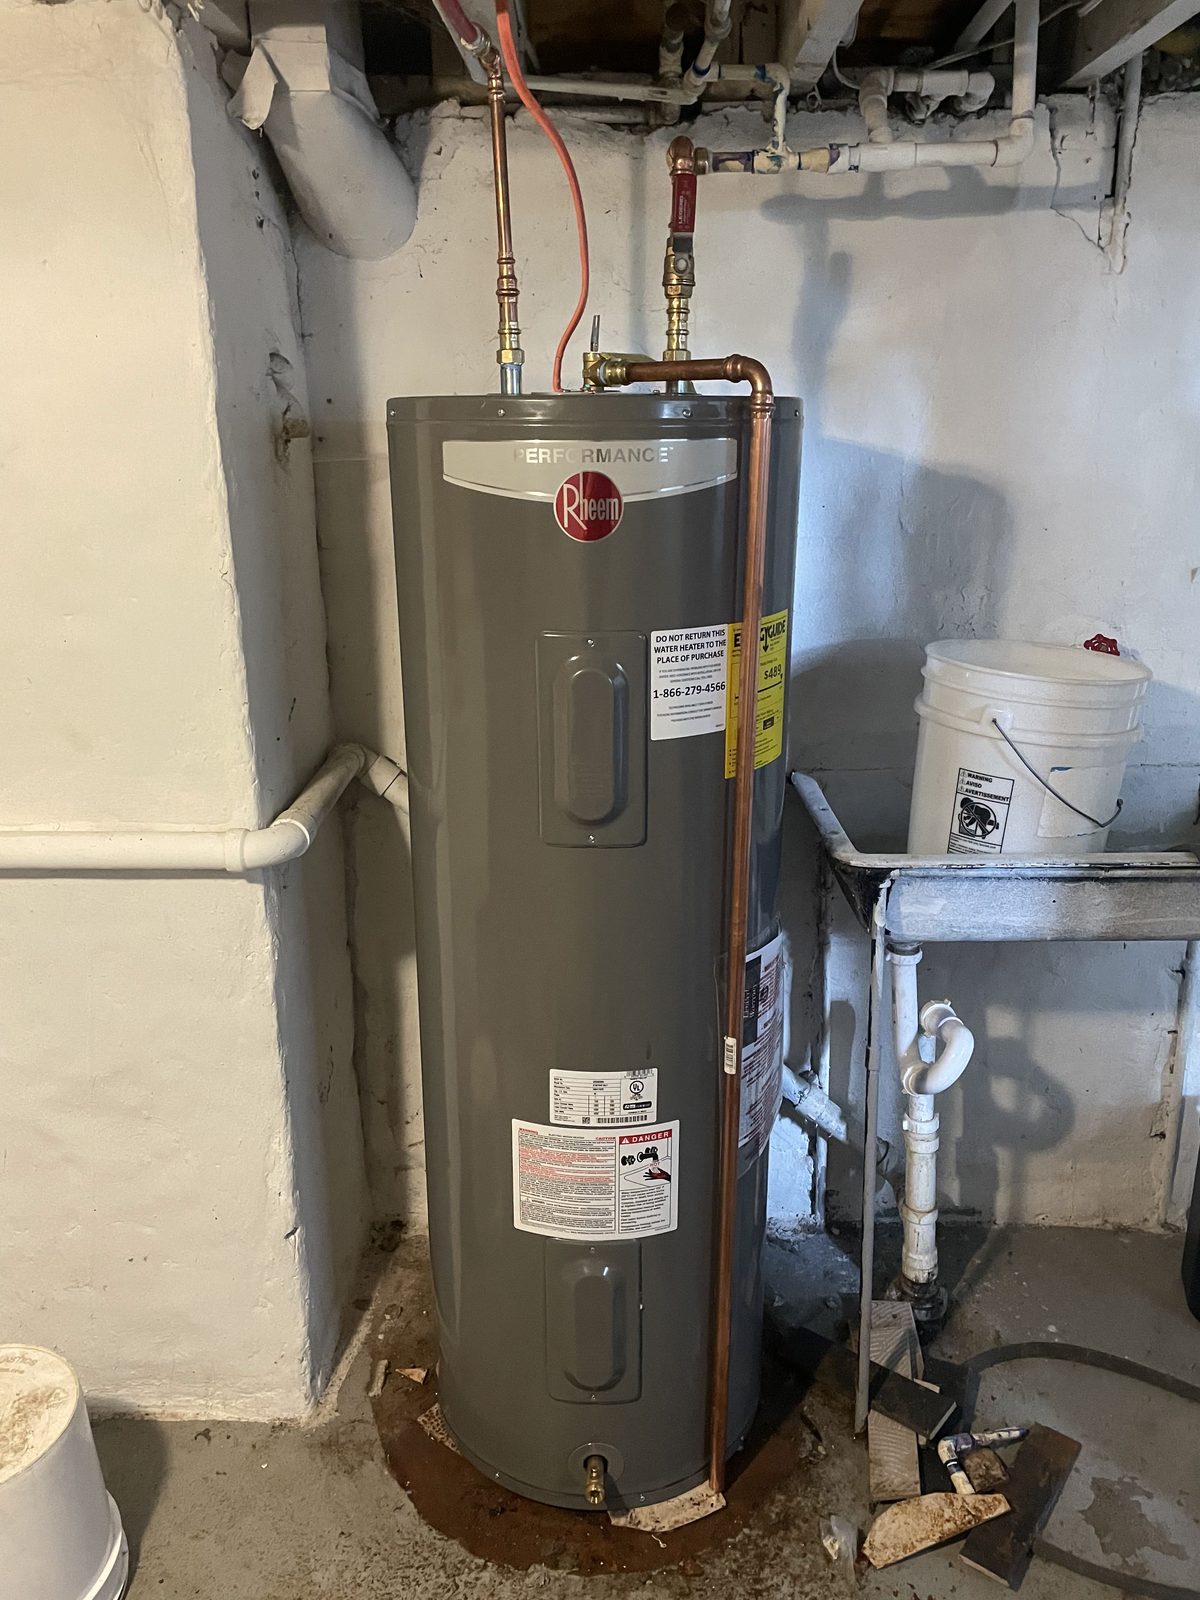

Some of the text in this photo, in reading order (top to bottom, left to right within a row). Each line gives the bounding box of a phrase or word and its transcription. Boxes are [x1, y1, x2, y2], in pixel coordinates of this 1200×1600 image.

[513, 447, 669, 463] PERFORMANCE
[563, 471, 619, 530] Rheem
[655, 628, 726, 643] DO NOT RETURN THIS
[653, 638, 727, 654] WATER HEATER TO THE
[656, 650, 725, 664] PLACE OF PURCHASE
[653, 681, 726, 699] 1-866-279-4566
[965, 780, 983, 789] AVISO
[967, 772, 993, 783] WARNING
[964, 788, 1010, 802] AVERTISSEMENT
[632, 1131, 669, 1143] DANGER
